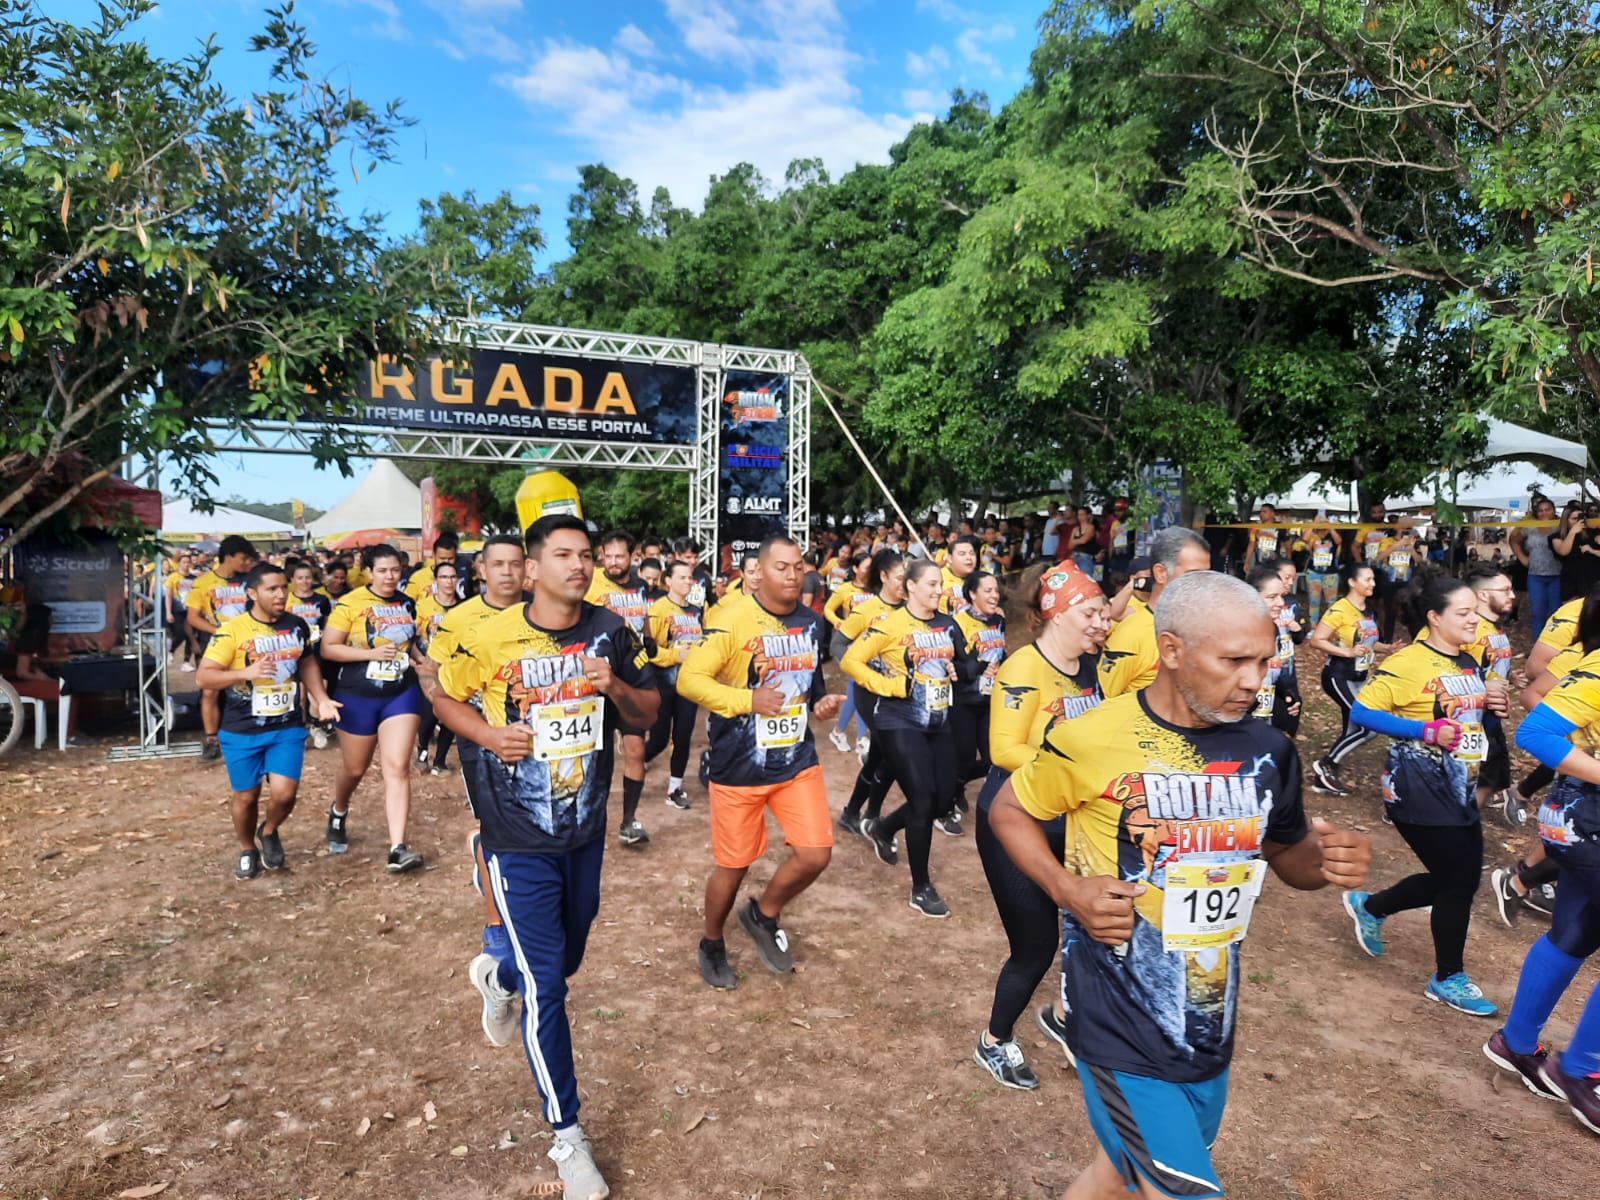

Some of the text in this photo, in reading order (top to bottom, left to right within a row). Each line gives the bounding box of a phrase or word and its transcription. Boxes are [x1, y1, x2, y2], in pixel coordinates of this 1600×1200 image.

[430, 409, 543, 429] ULTRAPASSA
[547, 416, 587, 431] ESSE
[591, 420, 652, 435] PORTAL
[744, 497, 782, 510] ALMT
[51, 557, 111, 570] Sicredi
[761, 633, 813, 658] ROTAM
[378, 660, 401, 672] 129
[262, 692, 289, 706] 130
[549, 715, 592, 742] 344
[767, 717, 799, 736] 965
[1141, 773, 1262, 820] ROTAM
[1177, 815, 1264, 854] EXTREME
[1183, 886, 1241, 924] 192
